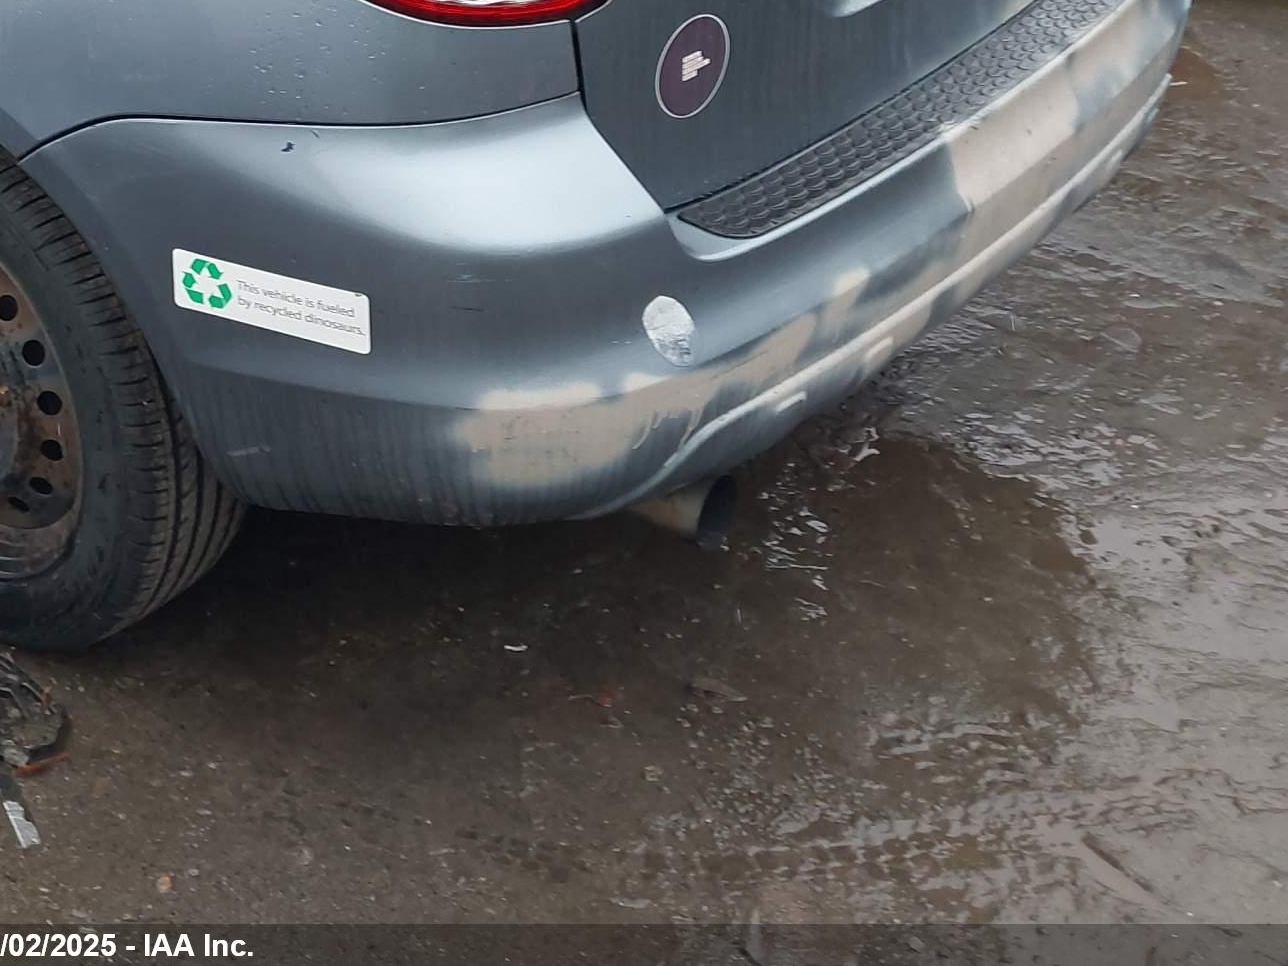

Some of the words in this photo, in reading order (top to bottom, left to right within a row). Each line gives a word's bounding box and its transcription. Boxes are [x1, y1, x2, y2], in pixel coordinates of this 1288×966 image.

[237, 280, 260, 296] This
[262, 288, 303, 306] vehicle
[305, 298, 315, 308] is
[316, 299, 355, 318] fueled
[238, 297, 251, 310] by
[254, 302, 302, 321] recycled
[304, 312, 366, 336] dinosaurs.
